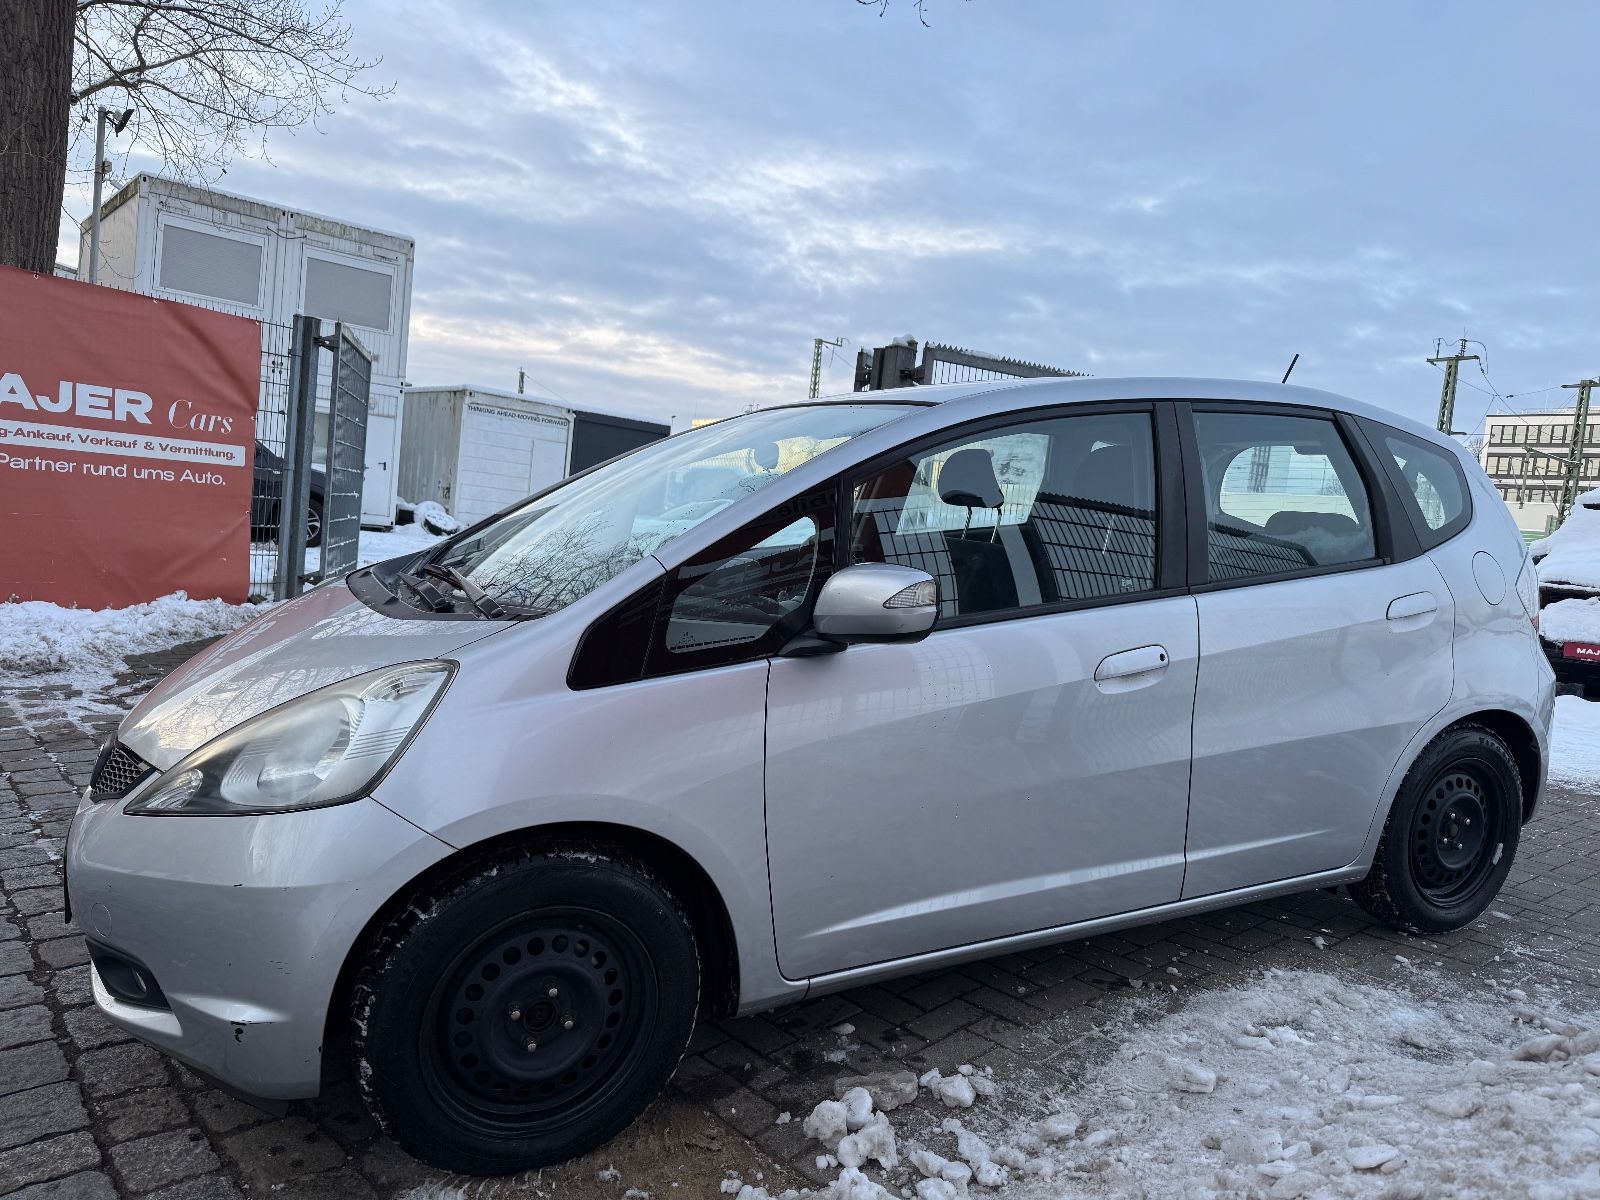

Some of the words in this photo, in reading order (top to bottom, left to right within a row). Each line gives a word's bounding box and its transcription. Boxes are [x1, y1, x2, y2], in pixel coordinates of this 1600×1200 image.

[168, 399, 233, 434] Cars
[467, 405, 495, 415] THINKING
[541, 418, 568, 427] FORWARD
[78, 433, 137, 449] Verkauf
[143, 441, 155, 451] &
[159, 442, 236, 460] Vermittlung.
[83, 463, 127, 478] rund
[133, 467, 175, 481] ums
[180, 469, 226, 486] Auto.
